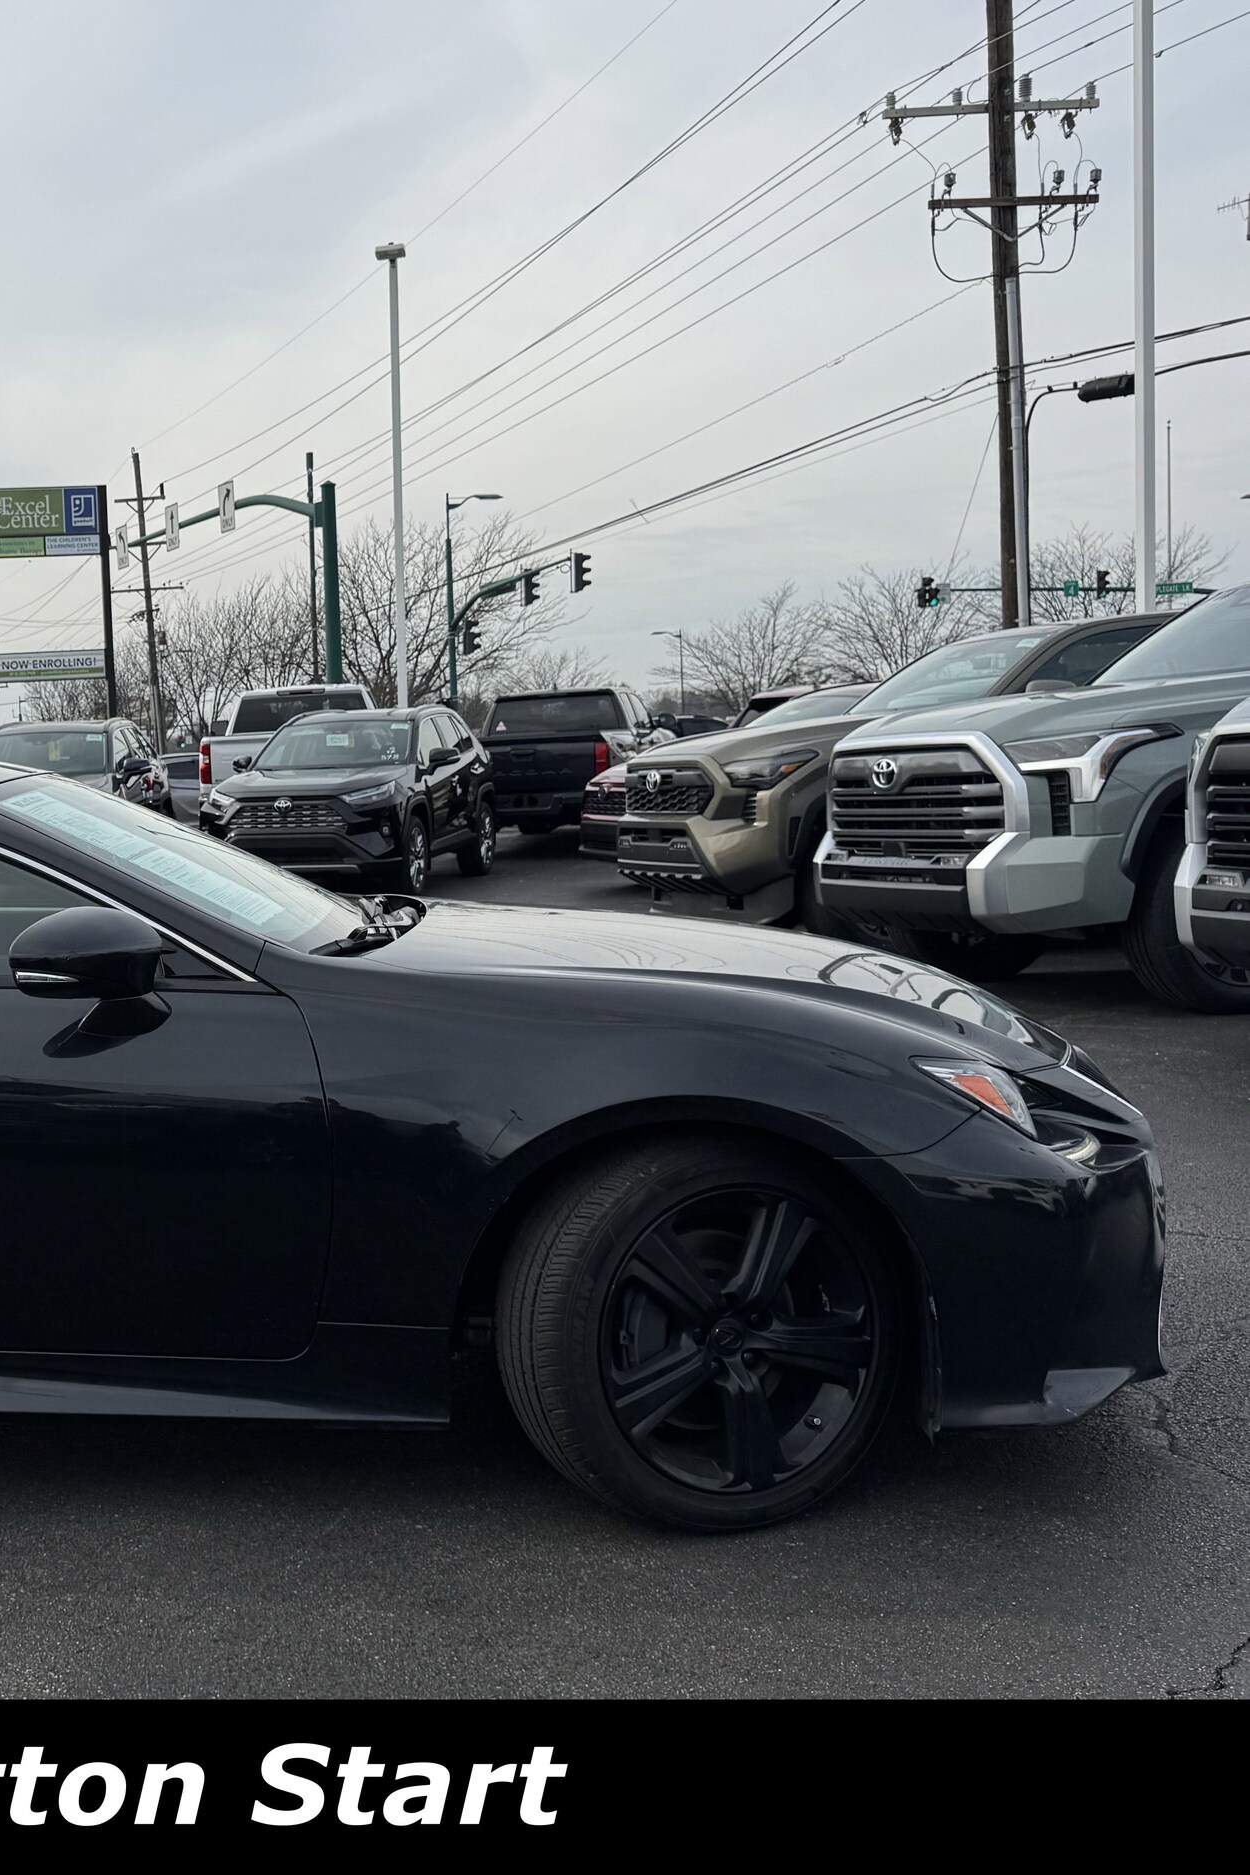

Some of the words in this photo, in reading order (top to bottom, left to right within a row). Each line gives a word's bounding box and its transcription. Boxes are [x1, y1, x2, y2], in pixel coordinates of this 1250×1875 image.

[2, 494, 51, 515] Excel
[1, 660, 29, 670] NOW
[32, 657, 96, 669] ENROLLING!
